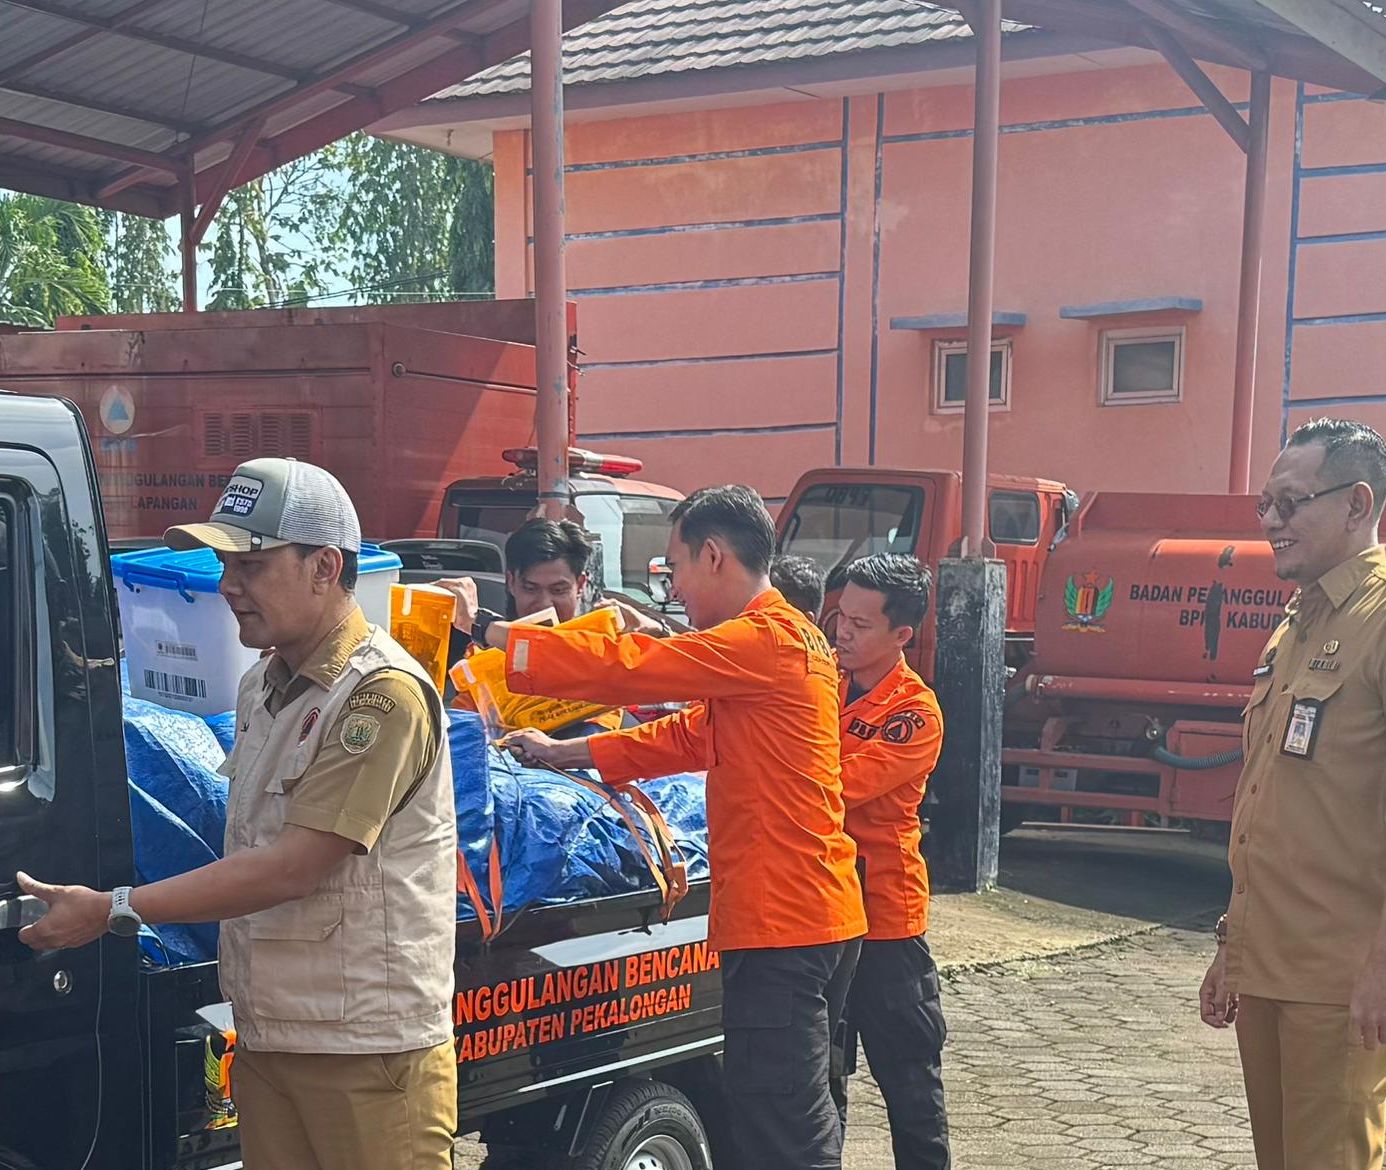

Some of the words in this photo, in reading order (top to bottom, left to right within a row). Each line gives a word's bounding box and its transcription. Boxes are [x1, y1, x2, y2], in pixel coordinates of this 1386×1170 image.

[1130, 584, 1183, 602] BADAN
[454, 959, 619, 1026] NGGULANGAN
[625, 941, 720, 988] BENCANA
[455, 1012, 565, 1064] ABUPATEN
[569, 984, 692, 1036] PEKALONGAN
